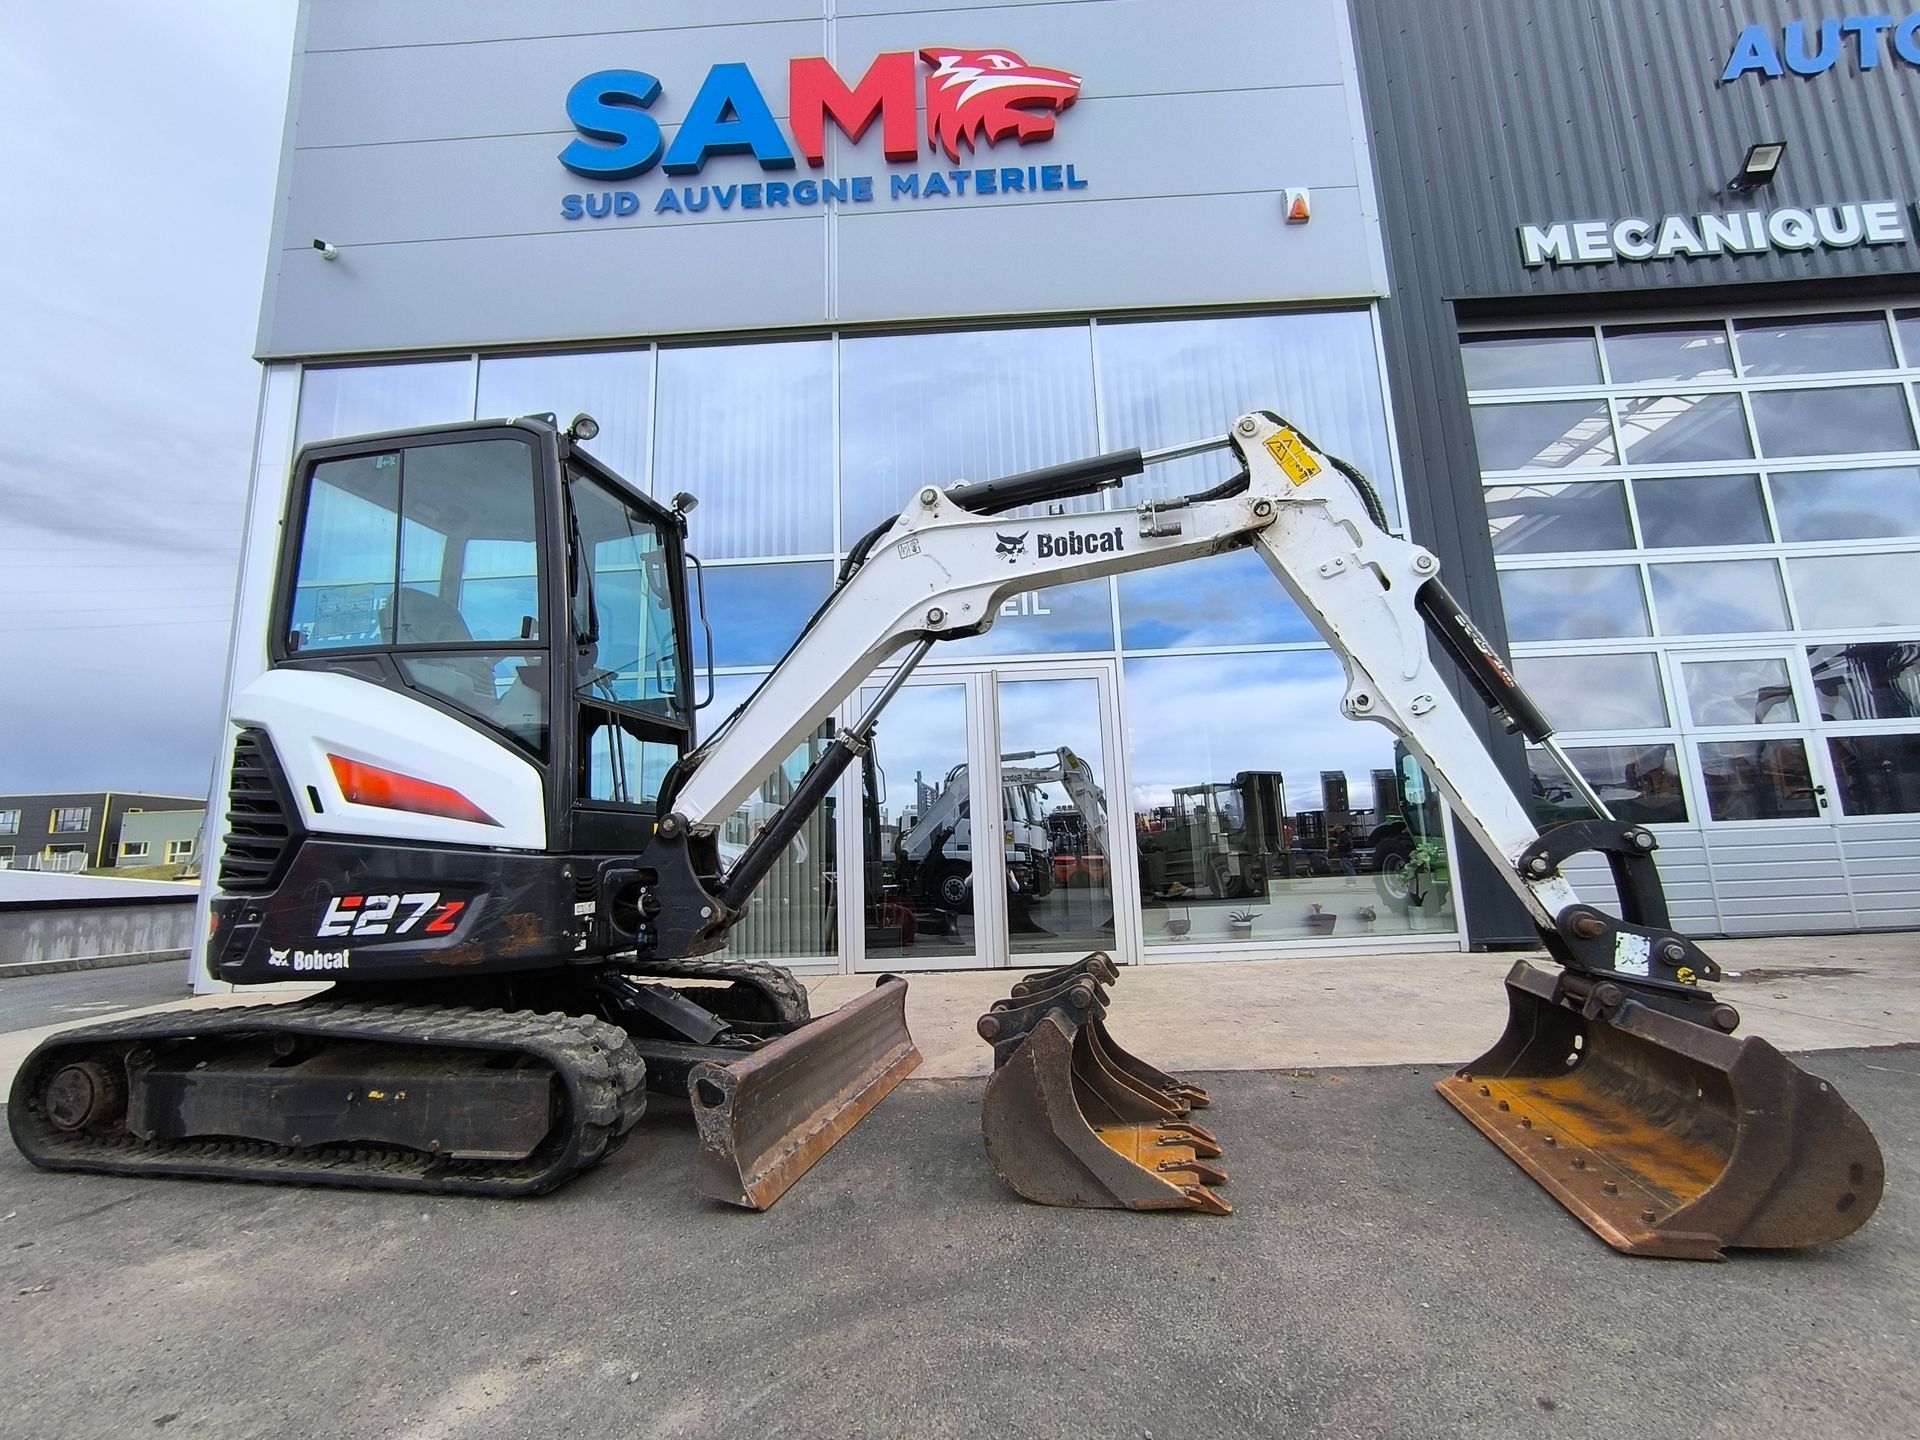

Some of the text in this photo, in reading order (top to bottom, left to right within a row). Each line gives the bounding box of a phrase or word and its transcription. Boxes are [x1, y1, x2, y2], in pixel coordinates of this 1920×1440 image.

[557, 50, 919, 180] SAM
[559, 164, 1088, 219] SUD AUVERGNE MATERIEL
[1520, 202, 1905, 265] MECANIQUE
[1037, 527, 1124, 558] Bobcat
[293, 949, 350, 971] Bobcat
